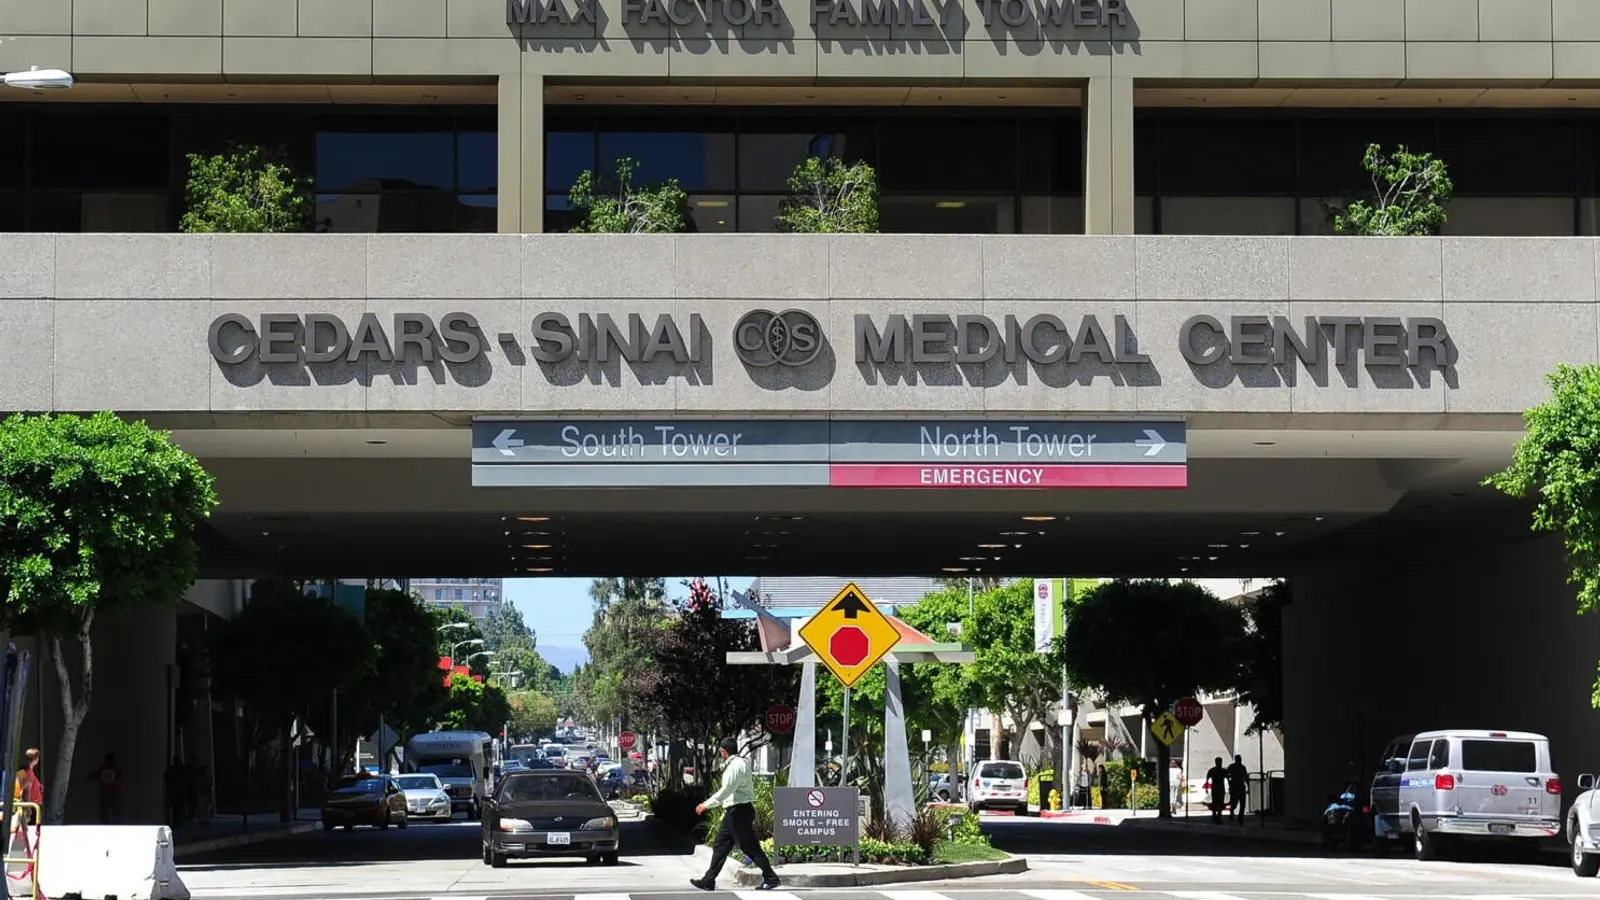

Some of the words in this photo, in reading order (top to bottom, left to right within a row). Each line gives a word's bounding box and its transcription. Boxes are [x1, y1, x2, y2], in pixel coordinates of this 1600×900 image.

[506, 0, 596, 25] MAX
[621, 0, 780, 26] FACTOR
[810, 0, 961, 26] FAMILY
[978, 0, 1126, 26] TOWER
[208, 312, 481, 364] CEDARS
[531, 312, 701, 363] SINAI
[854, 312, 1151, 365] MEDICAL
[1179, 315, 1450, 368] CENTER
[560, 426, 648, 457] South
[656, 426, 742, 457] Tower
[920, 426, 999, 457] North
[1006, 426, 1097, 457] Tower
[920, 469, 1044, 485] EMERGENCY
[768, 713, 793, 725] STOP
[1176, 706, 1201, 718] STOP
[1528, 797, 1537, 805] 11
[793, 809, 840, 818] ENTERING
[782, 818, 815, 827] SMOKE
[826, 818, 850, 827] FREE
[797, 827, 836, 836] CAMPUS
